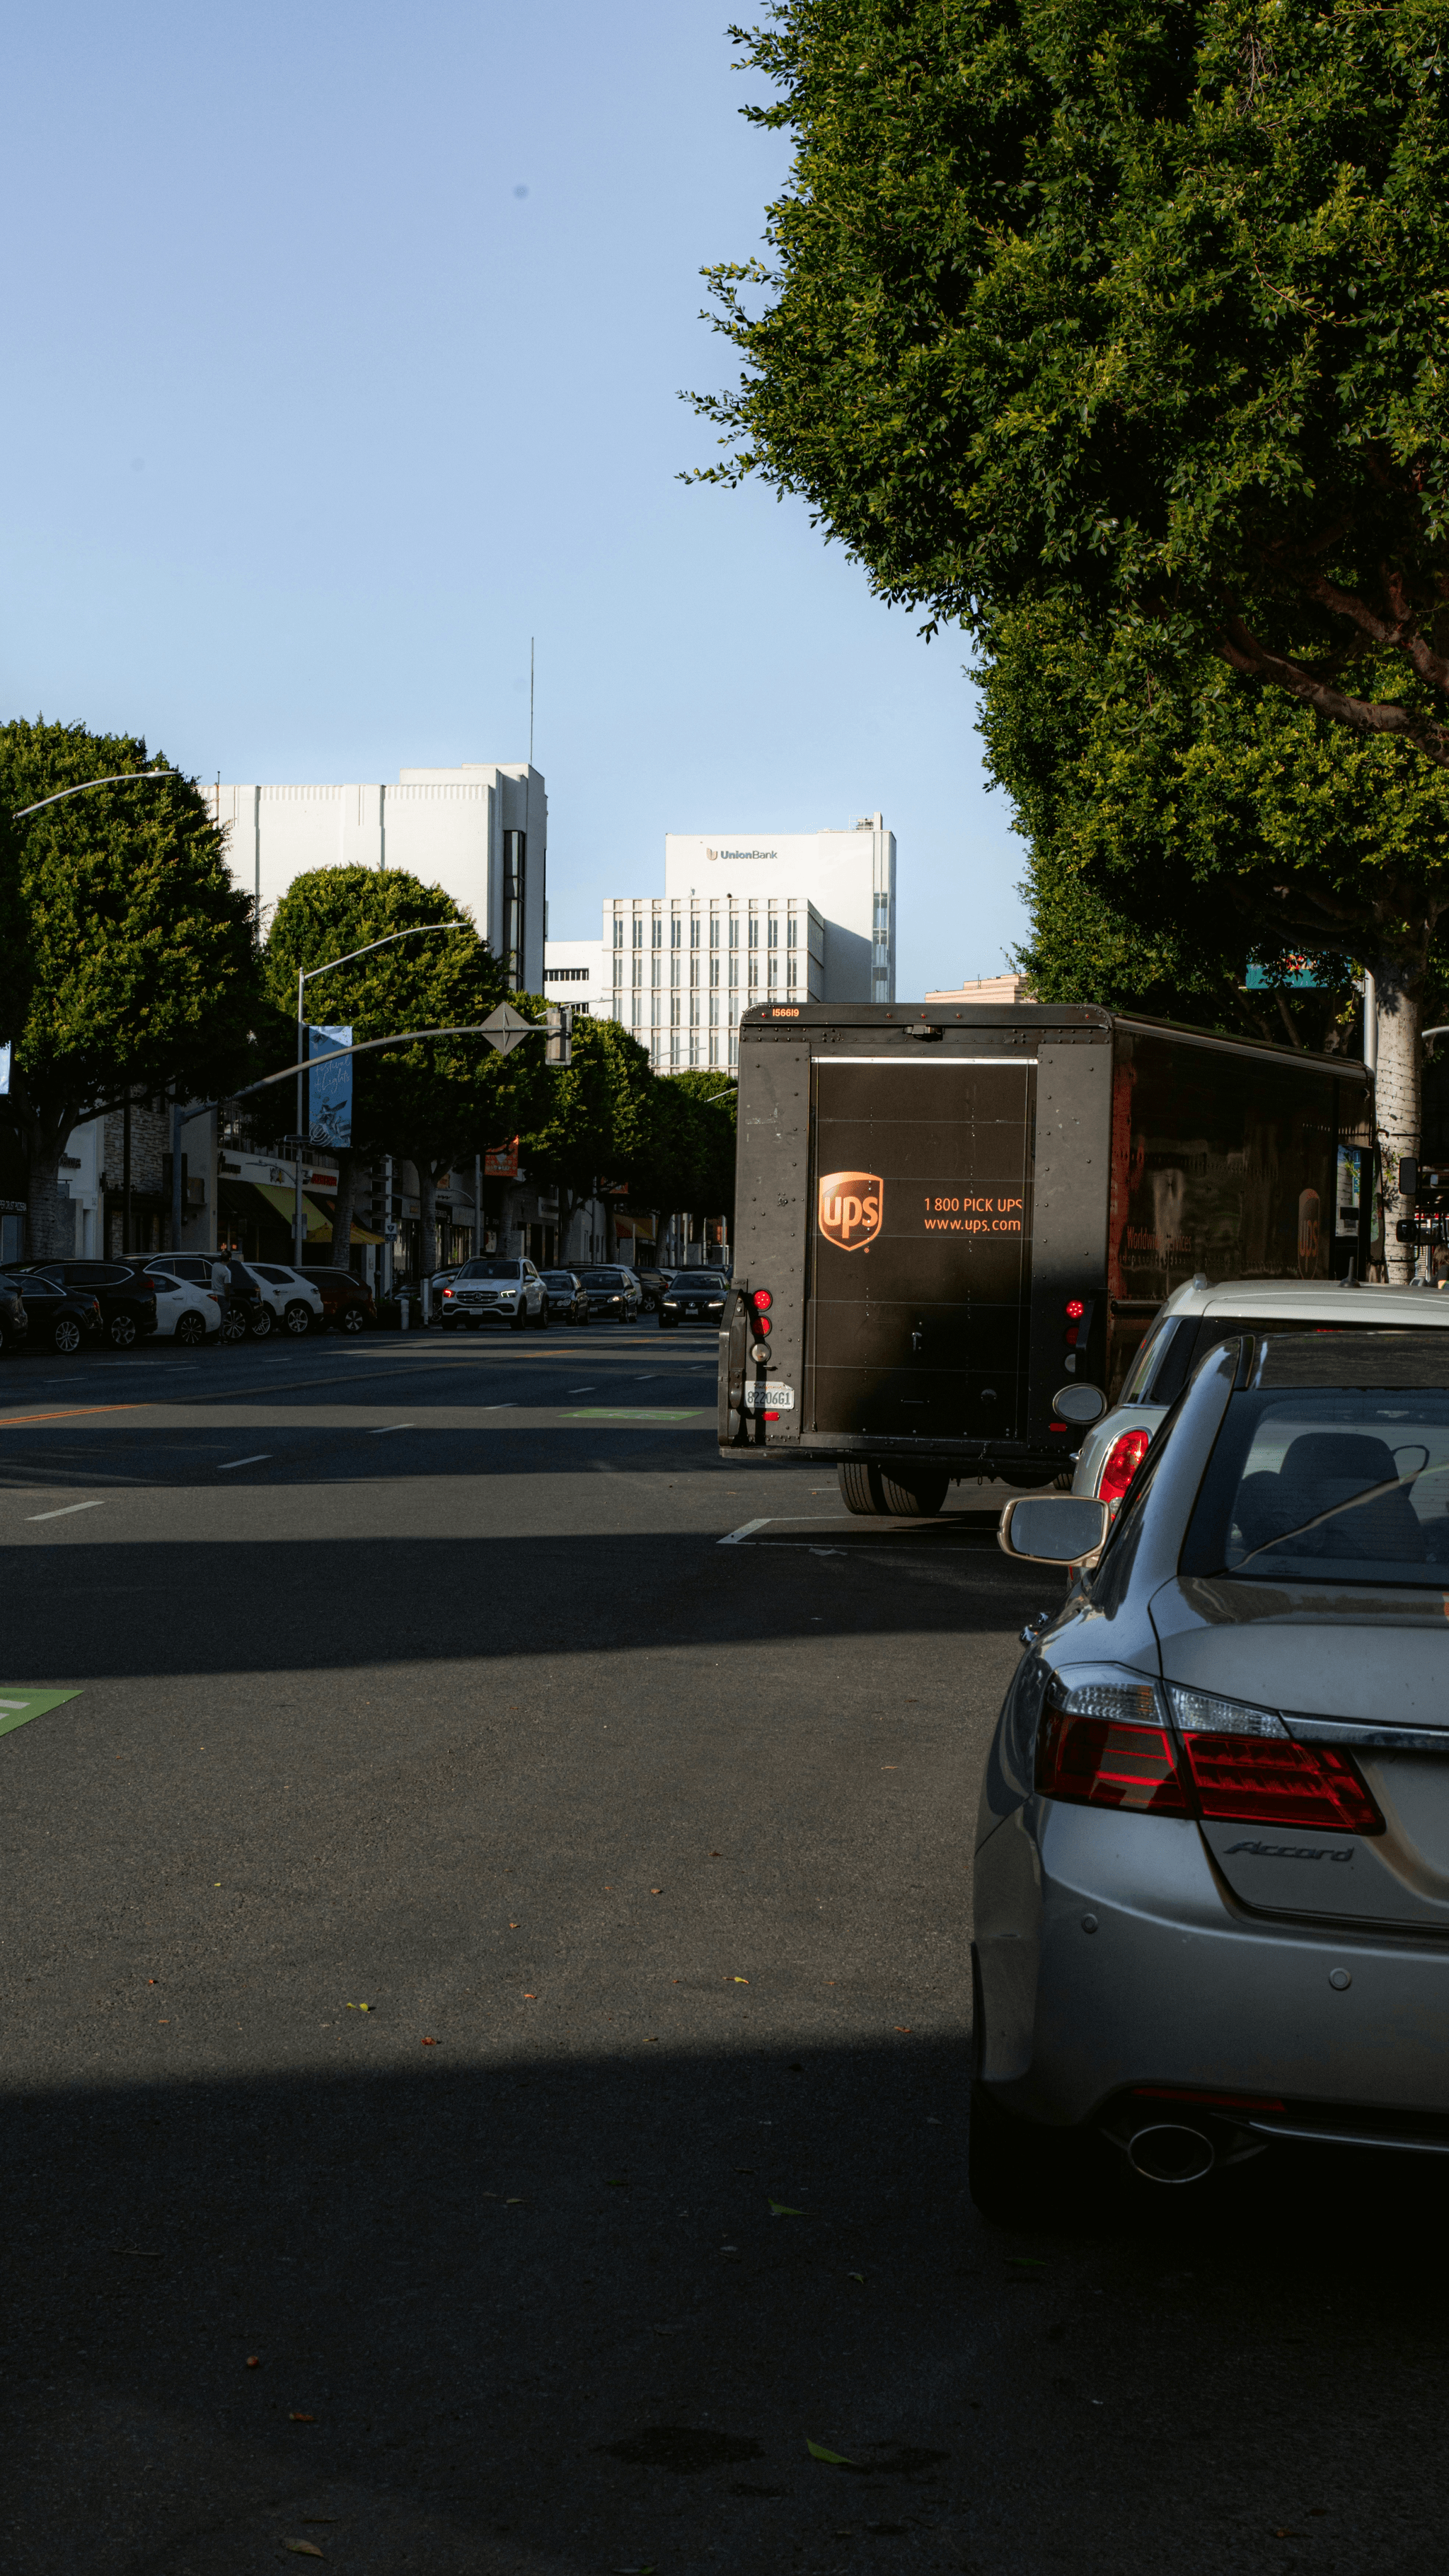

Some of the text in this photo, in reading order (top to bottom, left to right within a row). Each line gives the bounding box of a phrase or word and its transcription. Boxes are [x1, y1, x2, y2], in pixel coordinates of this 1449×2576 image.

[720, 850, 778, 859] UnionBank
[772, 1008, 799, 1016] 156619
[322, 1067, 351, 1093] Lights
[924, 1197, 930, 1211] 1
[934, 1197, 959, 1212] 800
[963, 1197, 993, 1212] PICK
[824, 1196, 879, 1239] ups
[924, 1219, 1021, 1234] www.ups.com
[748, 1391, 791, 1405] 82206G1
[1223, 1840, 1354, 1862] Accord
